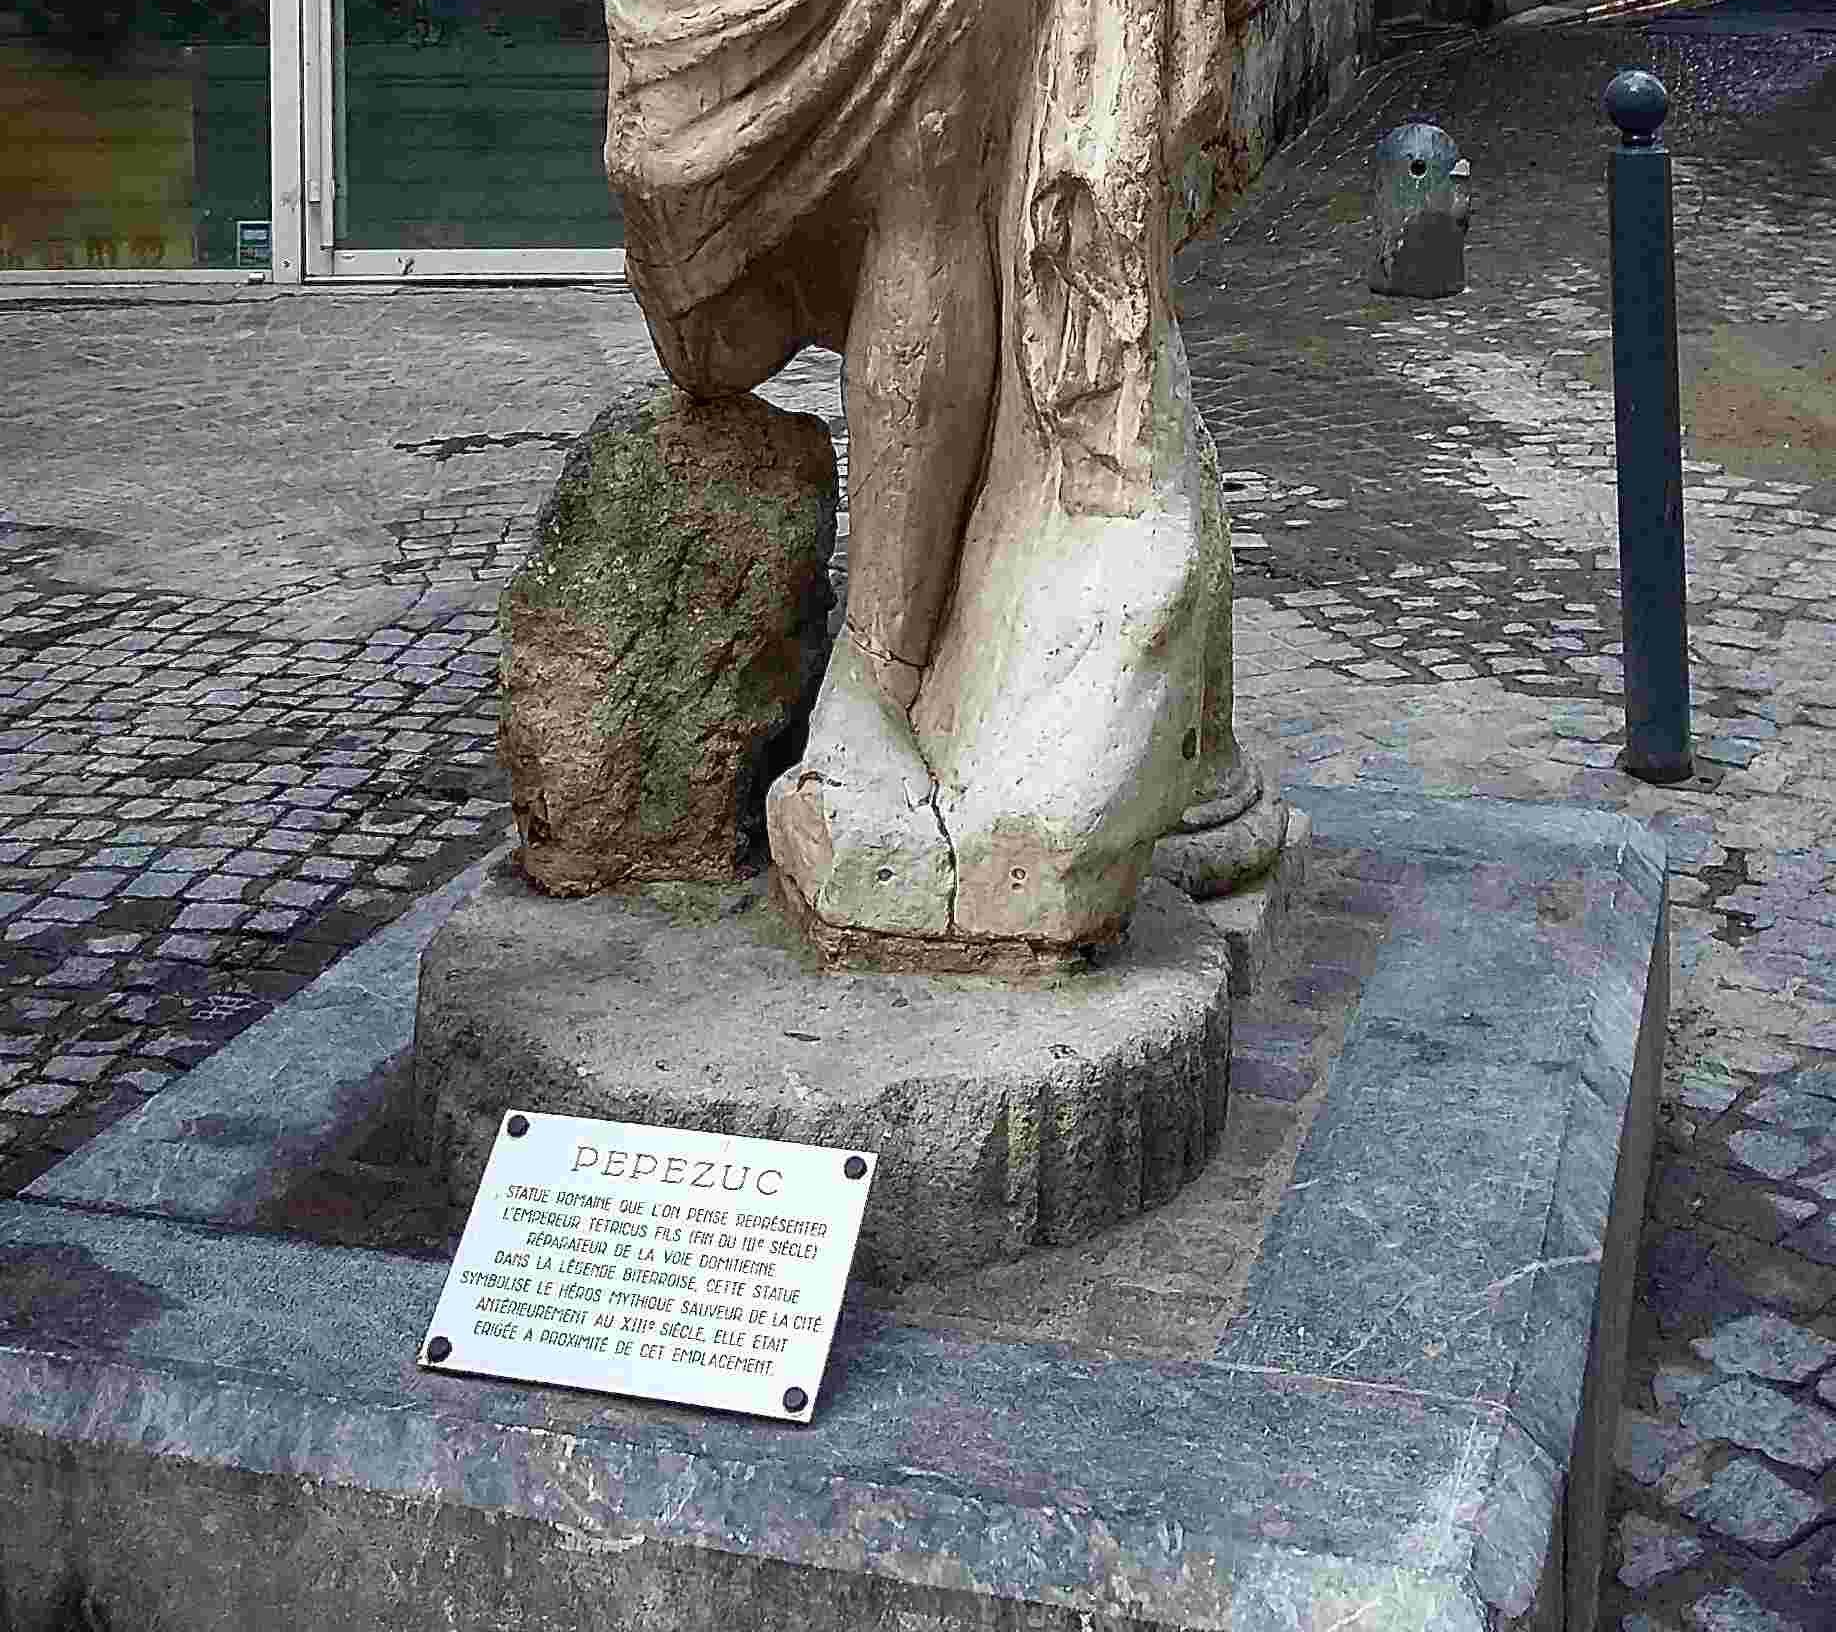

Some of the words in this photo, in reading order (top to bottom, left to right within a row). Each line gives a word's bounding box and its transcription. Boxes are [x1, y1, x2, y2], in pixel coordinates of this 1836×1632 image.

[570, 1145, 783, 1196] PEPEZUC
[503, 1207, 580, 1229] L'EMPEREUR
[589, 1216, 649, 1238] TETRICUS
[654, 1226, 682, 1242] FILS
[689, 1229, 714, 1246] (FIN
[718, 1233, 736, 1248] DU
[505, 1184, 550, 1203] STATUE
[556, 1191, 613, 1211] ROMAINE
[619, 1199, 647, 1215] QUE
[687, 1207, 729, 1226] PENSE
[736, 1213, 828, 1238] REPRÉSENTER
[494, 1250, 530, 1268] DANS
[536, 1256, 551, 1271] LA
[558, 1259, 616, 1280] LÉGENDE
[706, 1278, 747, 1297] CETTE
[752, 1285, 801, 1304] STATUE
[526, 1232, 608, 1255] RÉPARATEUR
[614, 1243, 633, 1259] DE
[637, 1247, 655, 1262] LA
[664, 1251, 693, 1266] VOIE
[700, 1254, 777, 1278] DOMITIENNE
[459, 1270, 532, 1293] SYMBOLISE
[536, 1281, 553, 1296] LE
[558, 1282, 602, 1302] HÉROS
[608, 1290, 675, 1313] MYTHIQUE
[680, 1300, 744, 1322] SAUVEUR
[749, 1309, 768, 1325] DE
[771, 1312, 788, 1328] LA
[793, 1315, 823, 1333] CITÉ
[475, 1296, 589, 1325] ANTÉRIEUREMENT
[593, 1313, 615, 1328] AU
[714, 1329, 747, 1347] ELLE
[523, 1327, 533, 1342] A
[540, 1329, 609, 1353] PROXIMITÉ
[614, 1340, 633, 1356] DE
[639, 1343, 665, 1360] CET
